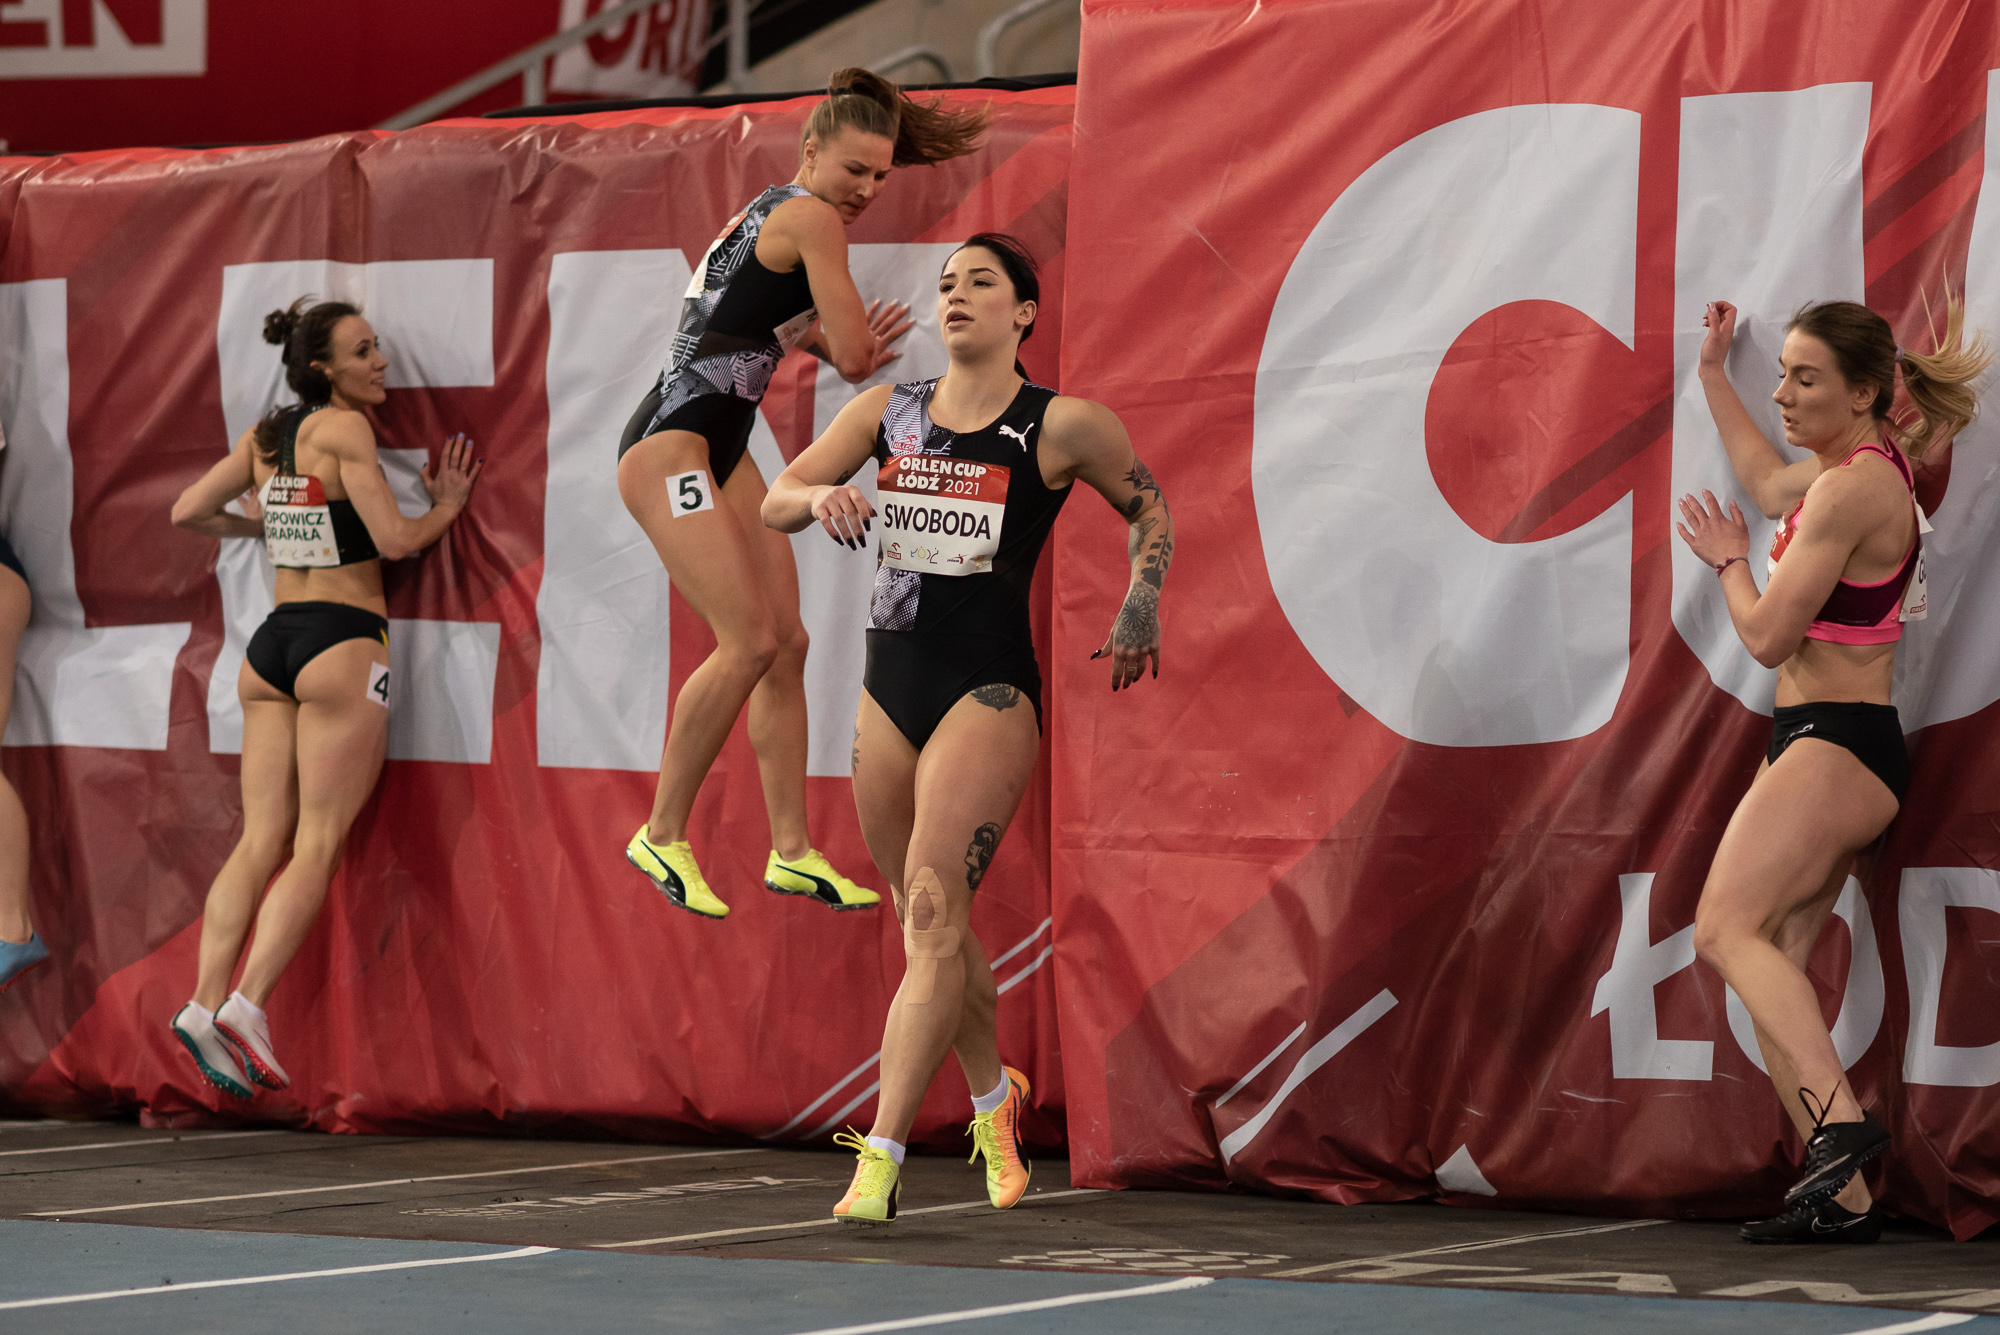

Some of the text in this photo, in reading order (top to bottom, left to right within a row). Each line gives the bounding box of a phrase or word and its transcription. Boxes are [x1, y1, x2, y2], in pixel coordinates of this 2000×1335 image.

[900, 456, 987, 479] ORLEN CUP
[678, 474, 703, 511] 5
[897, 471, 980, 496] ŁÓDŹ 2021
[290, 490, 308, 504] 2021
[265, 511, 325, 525] OPOWICZ
[885, 503, 991, 540] SWOBODA
[373, 671, 389, 702] 4
